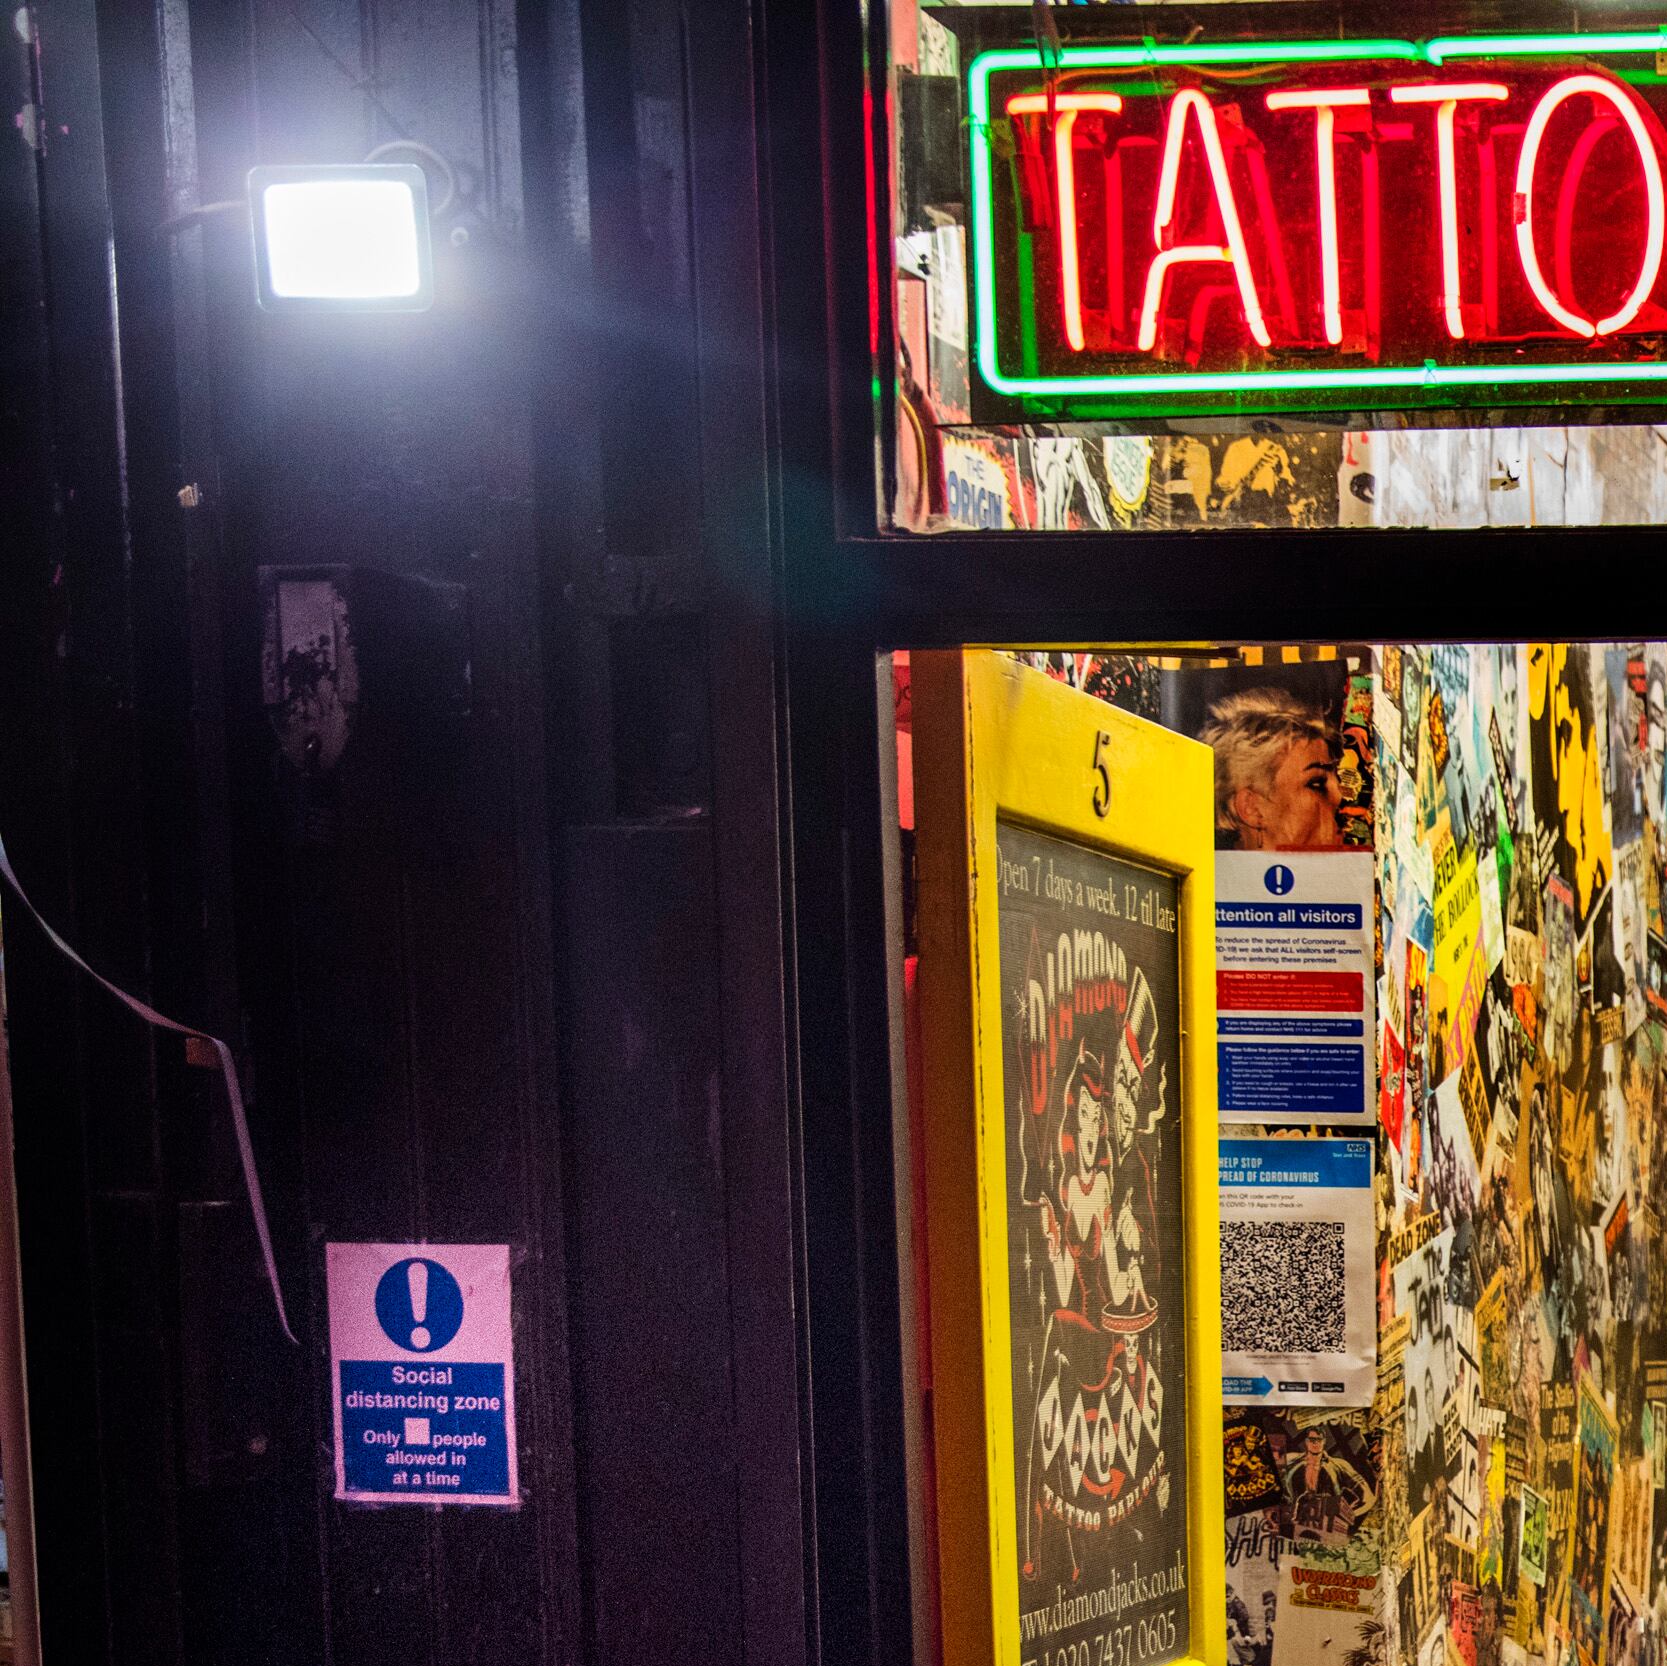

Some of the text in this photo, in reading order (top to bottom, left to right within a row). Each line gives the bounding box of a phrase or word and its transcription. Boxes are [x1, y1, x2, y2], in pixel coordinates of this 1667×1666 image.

[1092, 730, 1111, 818] 5
[1033, 856, 1176, 933] 7 days a week. 12 til late
[1278, 909, 1356, 924] all visitors
[1028, 928, 1128, 1116] DIAMOND
[1242, 1157, 1263, 1169] STOP
[1259, 1172, 1320, 1184] CORONAVIRUS
[1389, 1212, 1441, 1264] DEAD ZONE
[392, 1366, 452, 1385] Social
[346, 1391, 500, 1414] distancing zone
[363, 1430, 486, 1449] Only people
[386, 1450, 466, 1466] allowed in
[393, 1471, 461, 1486] at a time
[1020, 1550, 1186, 1643] ww.diamondjacks.co.uk
[1138, 1609, 1176, 1659] 0605
